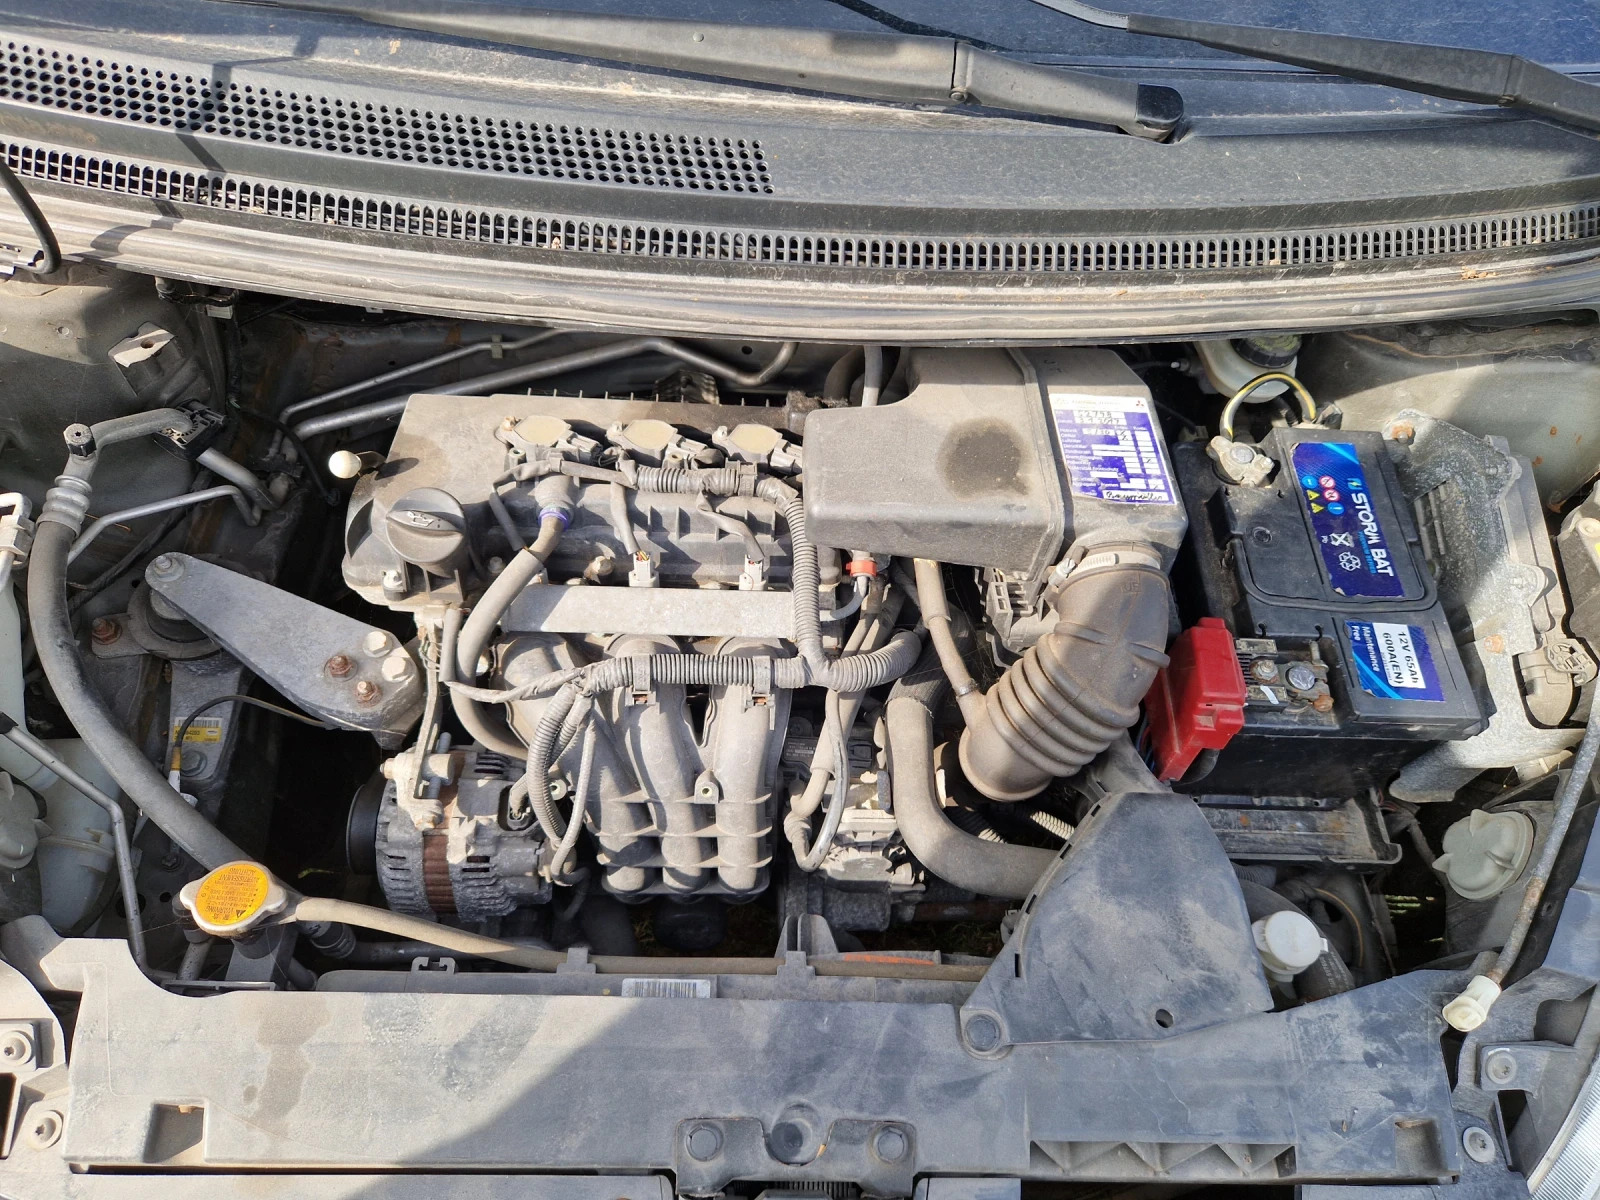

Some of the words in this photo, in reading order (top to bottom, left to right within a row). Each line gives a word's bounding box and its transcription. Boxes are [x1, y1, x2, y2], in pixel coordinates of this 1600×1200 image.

[1321, 535, 1329, 544] Pb
[1352, 492, 1381, 545] STORM
[1370, 548, 1394, 577] BAT
[1352, 625, 1361, 641] Free
[1361, 626, 1380, 672] Maintenance
[1397, 631, 1411, 652] 12V
[1405, 655, 1419, 684] 65Ah
[1382, 632, 1405, 684] 600A(EN)
